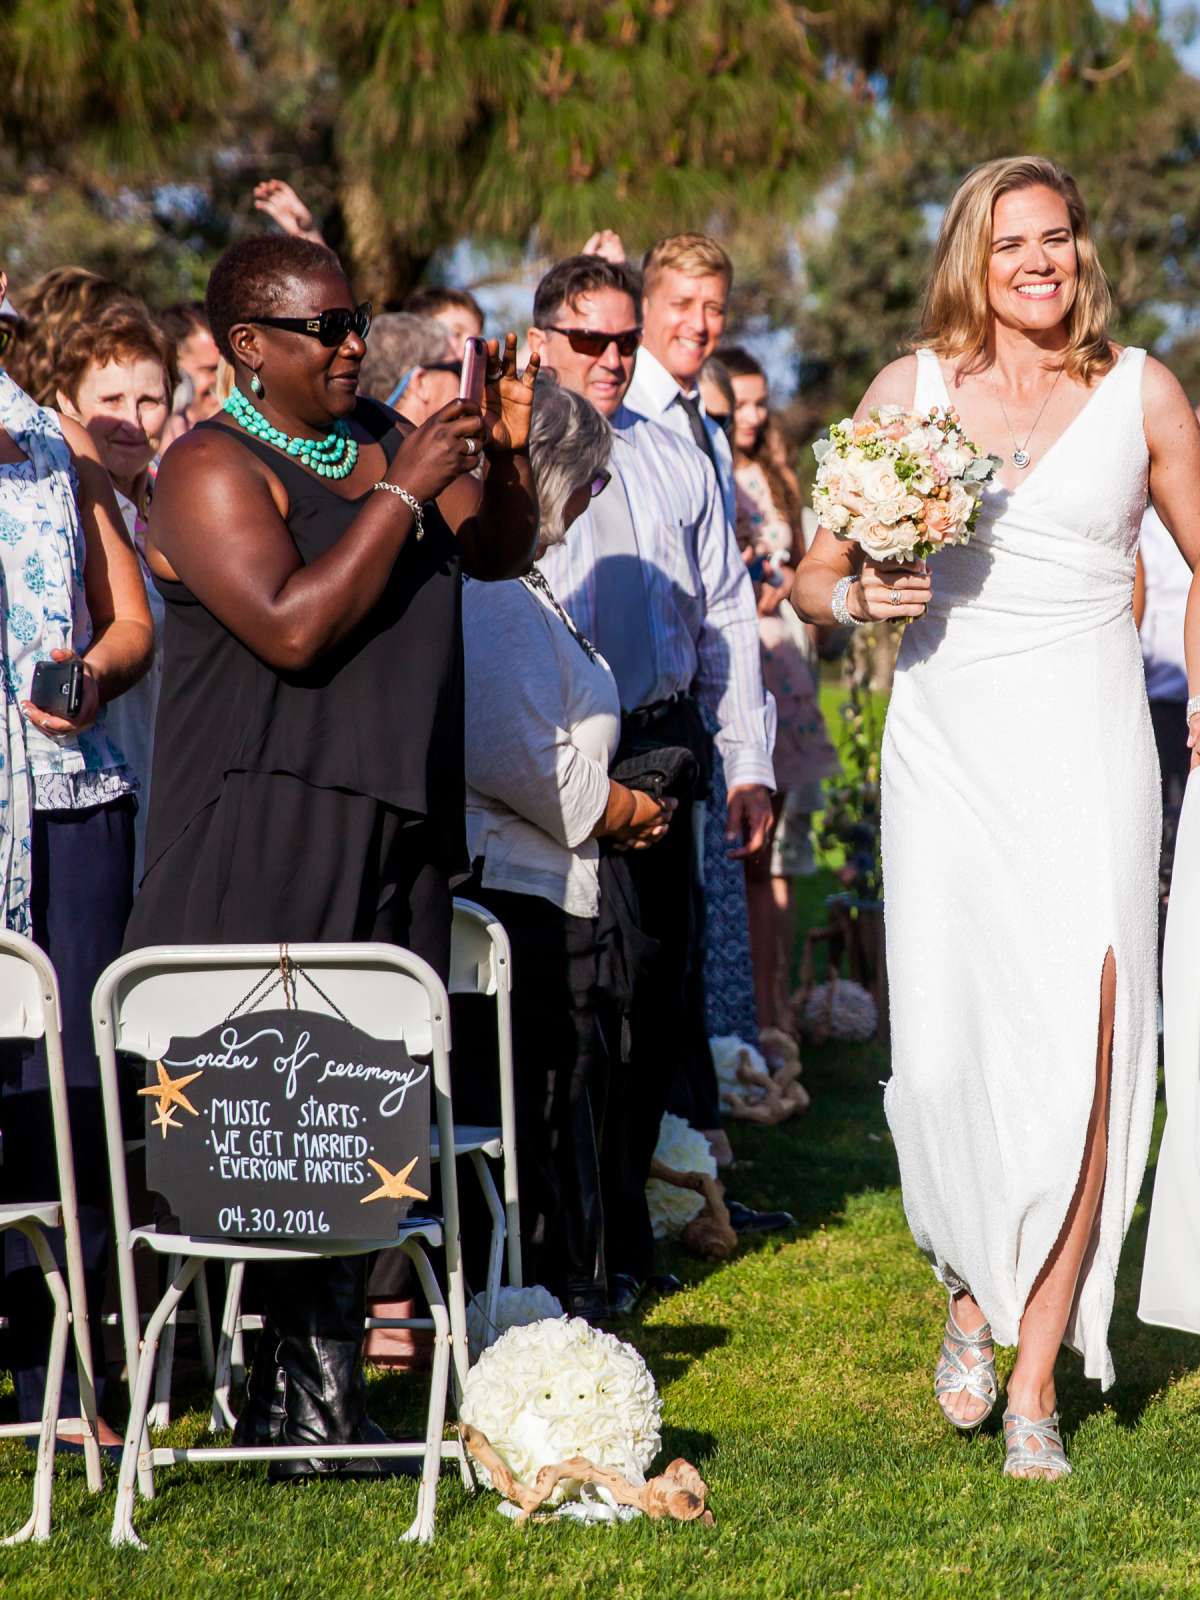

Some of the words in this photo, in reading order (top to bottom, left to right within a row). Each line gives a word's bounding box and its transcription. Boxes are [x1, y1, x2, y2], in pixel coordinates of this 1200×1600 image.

[163, 1027, 283, 1069] order
[273, 1031, 319, 1100] of
[318, 1059, 429, 1117] ceremony
[211, 1098, 271, 1127] MUSIC
[210, 1130, 241, 1156] WE
[249, 1130, 283, 1157] GET
[293, 1133, 368, 1159] MARRIED
[220, 1157, 298, 1182] EVERYONE
[304, 1159, 364, 1185] PARTIES
[218, 1205, 331, 1234] 04.30.2016
